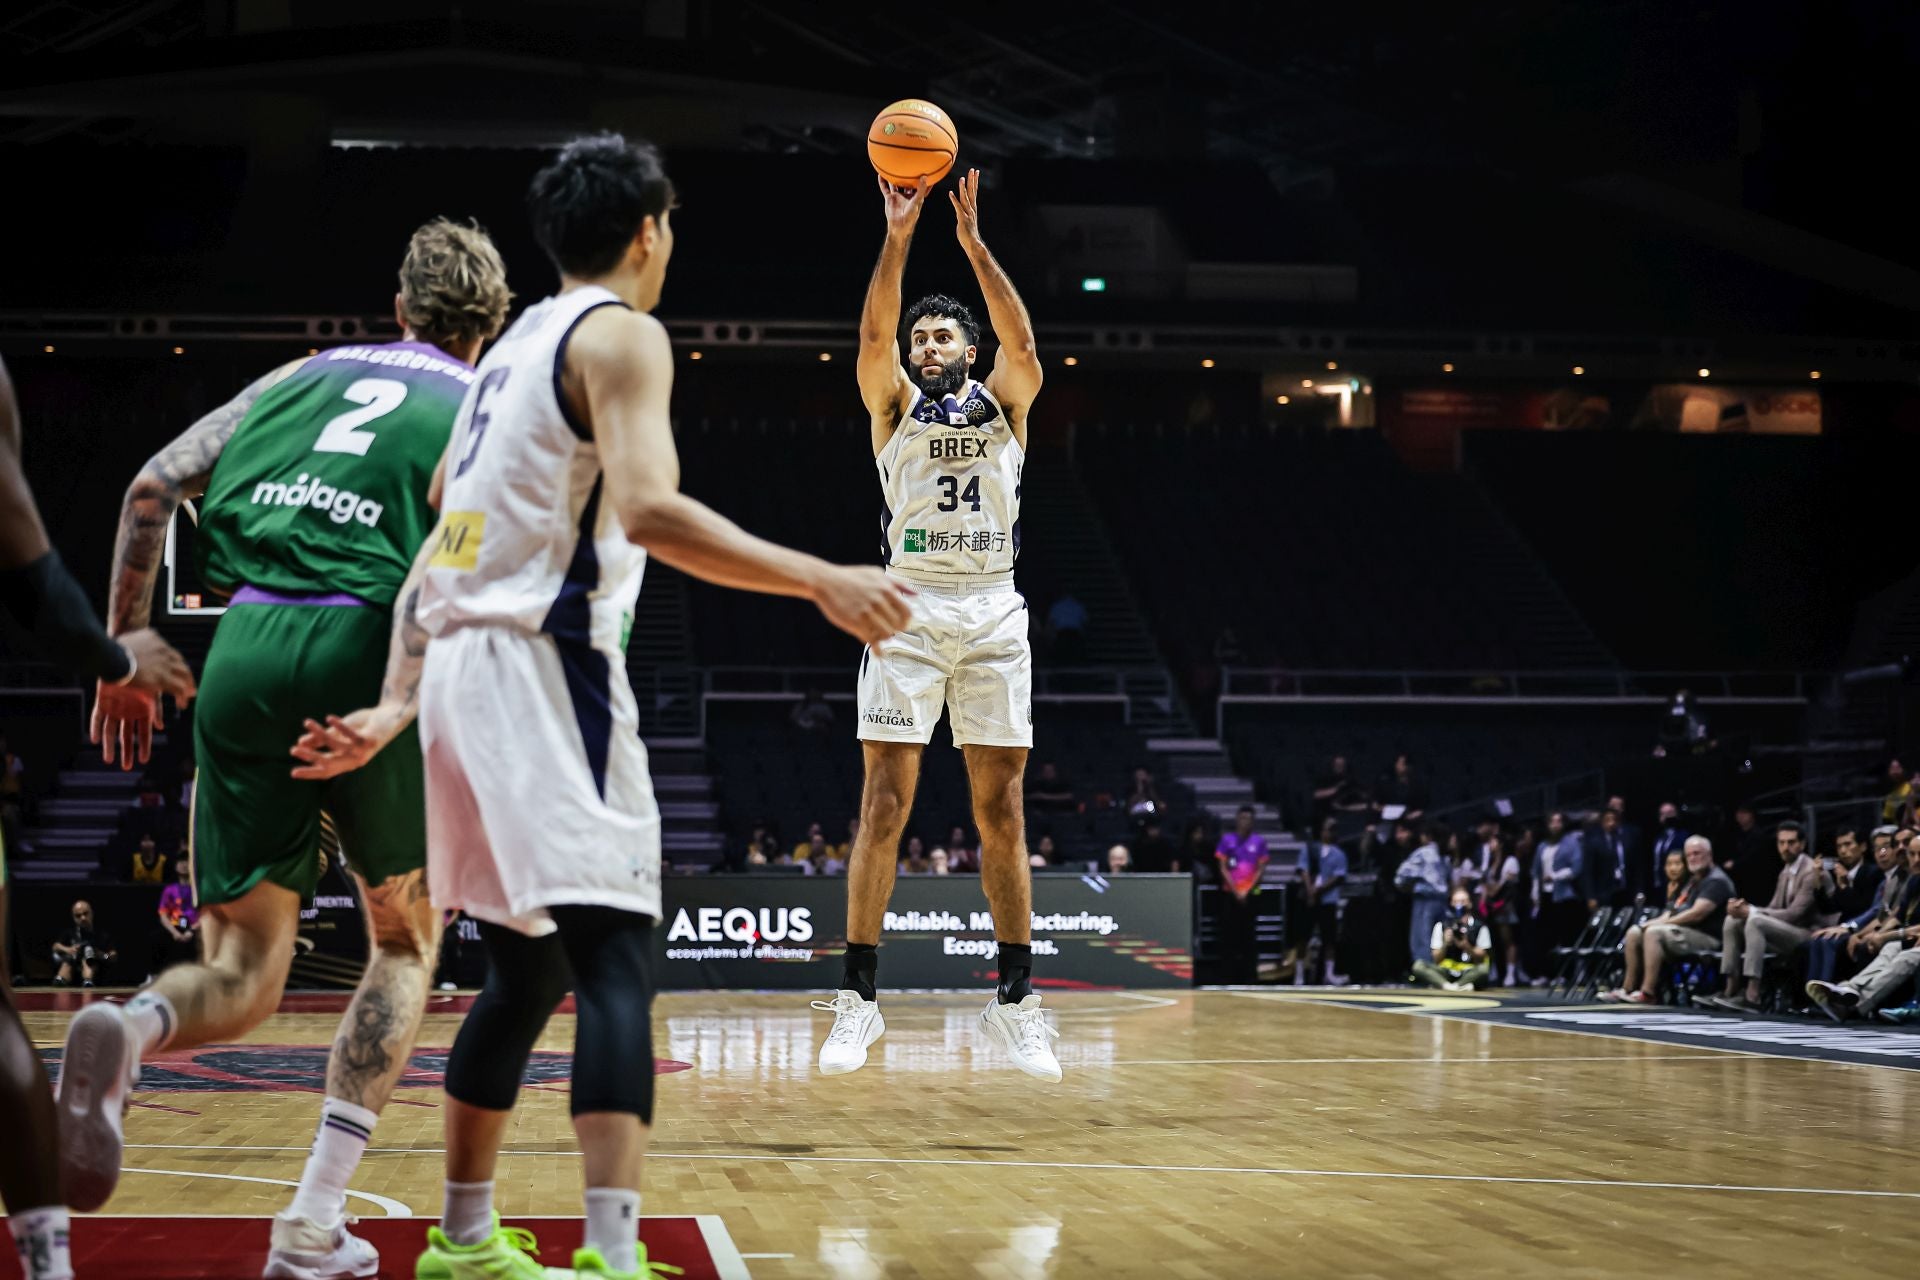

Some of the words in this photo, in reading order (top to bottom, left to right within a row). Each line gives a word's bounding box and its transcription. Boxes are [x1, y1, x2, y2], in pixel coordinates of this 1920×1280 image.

[312, 377, 408, 457] 2
[929, 437, 989, 460] BREX
[250, 472, 385, 528] málaga
[936, 475, 981, 513] 34
[927, 530, 1006, 552] 栃木銀行
[867, 713, 914, 727] NICIGAS
[667, 907, 813, 945] AEQUS
[882, 911, 966, 931] Reliable.
[969, 911, 1119, 935] Macturing.
[665, 947, 738, 962] ecosystems
[739, 944, 754, 959] of
[754, 945, 814, 962] efficiency
[943, 936, 1059, 960] Ecosyms.
